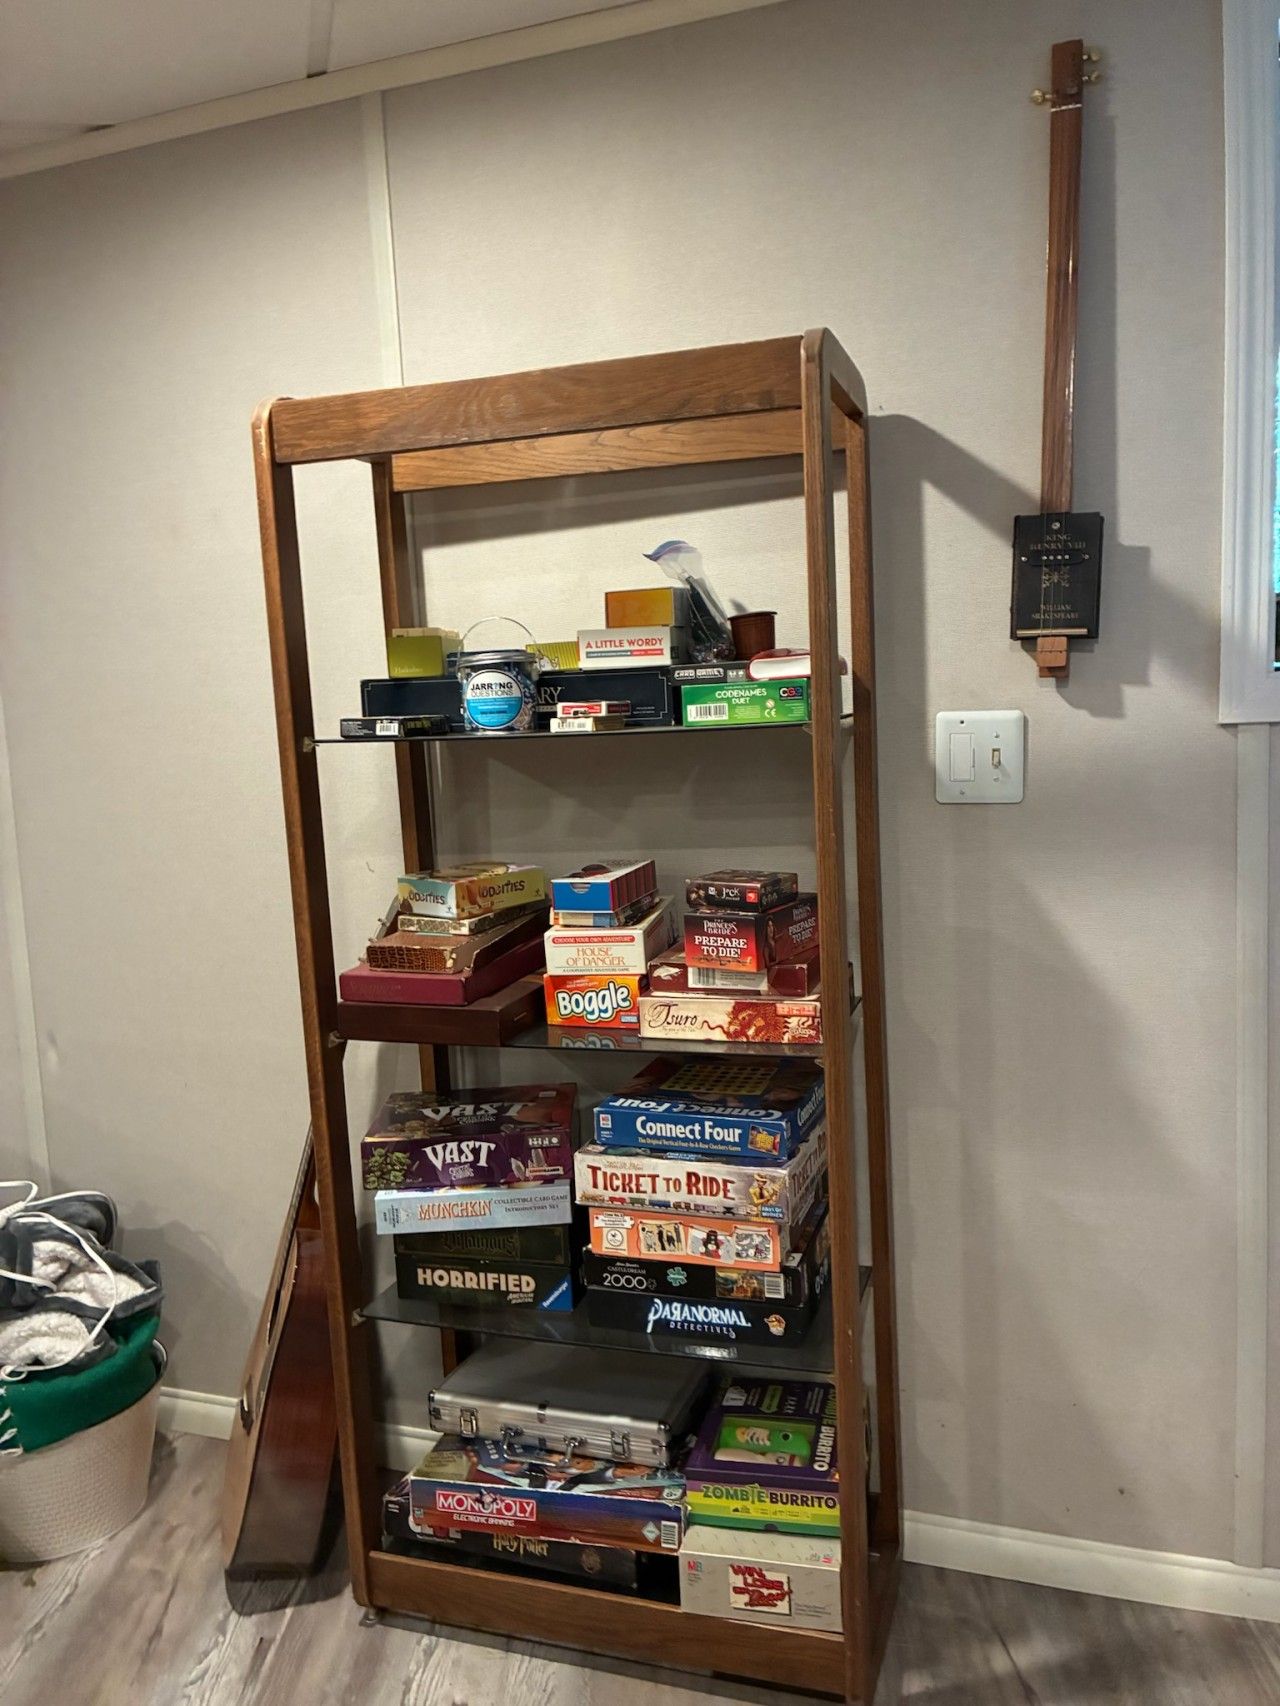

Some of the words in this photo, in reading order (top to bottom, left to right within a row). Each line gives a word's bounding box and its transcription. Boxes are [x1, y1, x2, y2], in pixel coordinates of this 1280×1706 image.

[585, 641, 593, 649] A
[595, 639, 625, 649] LITTLE
[625, 637, 664, 647] WORDY
[715, 688, 767, 699] CODENAMES
[576, 947, 613, 957] HOUSE
[694, 935, 747, 949] PREPARE
[701, 945, 717, 957] TO
[718, 947, 741, 958] DIE!
[566, 958, 582, 967] OF
[581, 956, 626, 966] DANGER
[556, 979, 632, 1021] Boggle
[648, 1003, 698, 1028] Tsuro
[420, 1102, 536, 1121] VAST
[635, 1115, 701, 1140] Connect
[704, 1121, 742, 1143] Four
[646, 1137, 663, 1146] Original
[422, 1140, 496, 1171] VAST
[586, 1163, 660, 1195] TICKET
[662, 1177, 682, 1193] TO
[686, 1171, 736, 1201] RIDE
[417, 1200, 491, 1221] MUNCHKIN
[494, 1197, 533, 1205] COLLECTIBLE
[416, 1267, 536, 1293] HORRIFIED
[602, 1273, 646, 1290] 2000
[646, 1298, 752, 1333] PARANORMAL
[669, 1321, 736, 1339] DETECTIVES
[813, 1425, 836, 1472] BURRITO
[439, 1494, 534, 1517] MONOPOLY
[702, 1483, 767, 1504] ZOMBIE
[769, 1491, 837, 1510] BURRITO
[453, 1513, 487, 1524] ELECTRONIC
